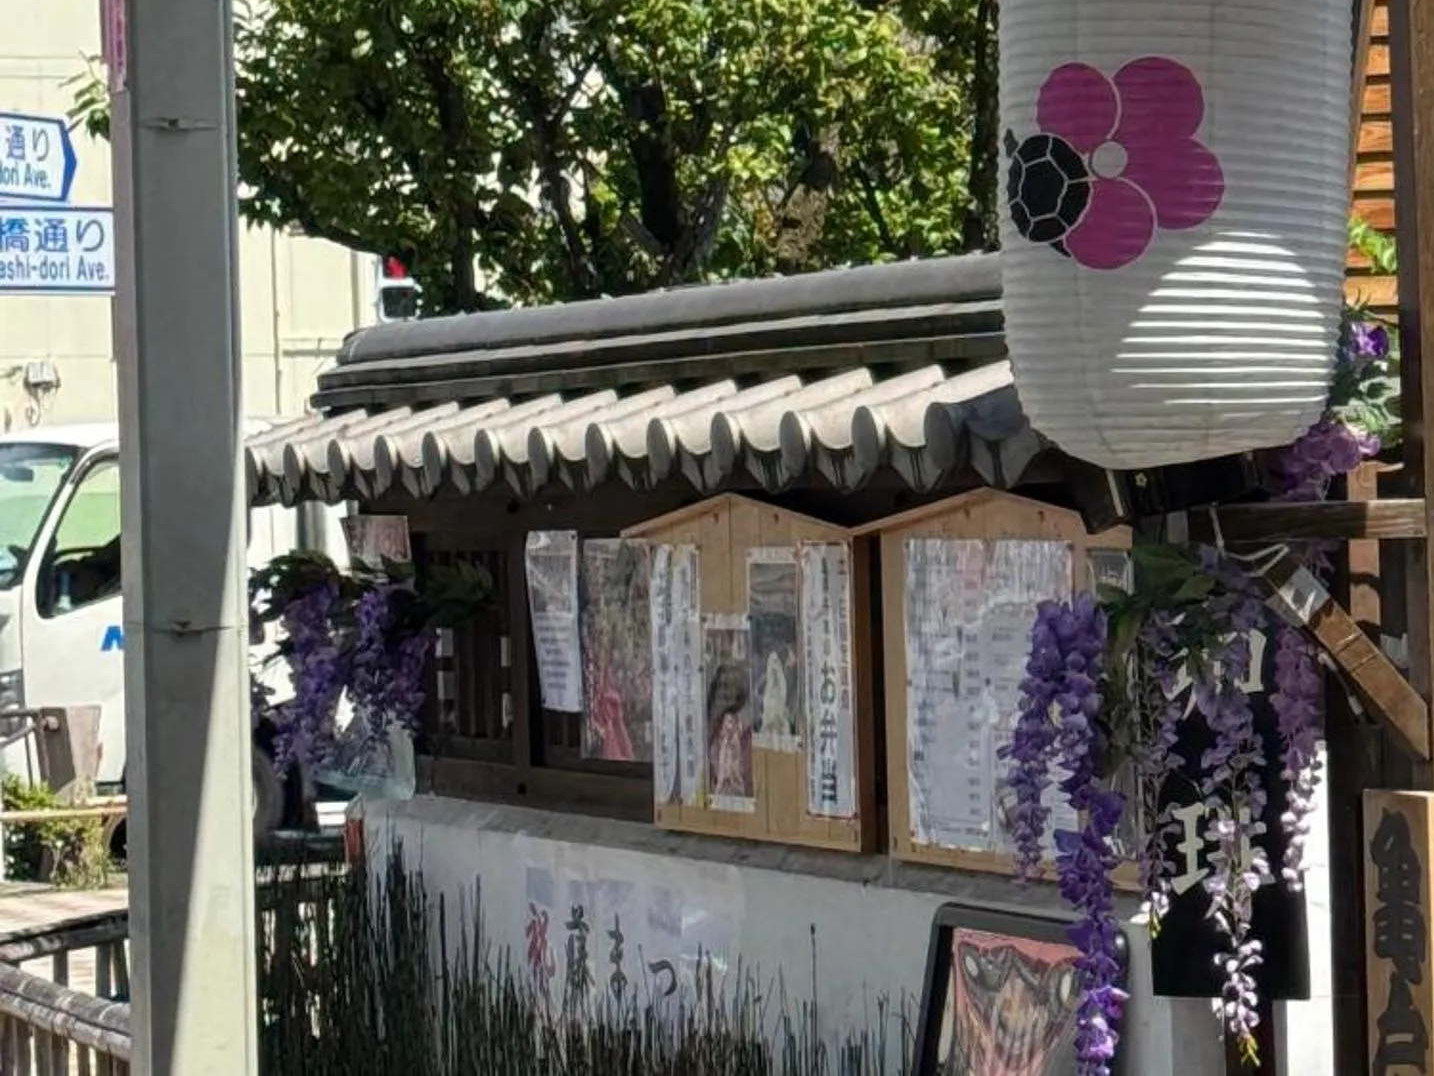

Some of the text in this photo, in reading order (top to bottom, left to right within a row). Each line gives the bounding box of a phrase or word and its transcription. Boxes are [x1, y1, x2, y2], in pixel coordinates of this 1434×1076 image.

[6, 125, 49, 162] 通り
[24, 163, 52, 188] Ave.
[0, 217, 105, 252] 橋通り
[76, 255, 109, 280] Ave.
